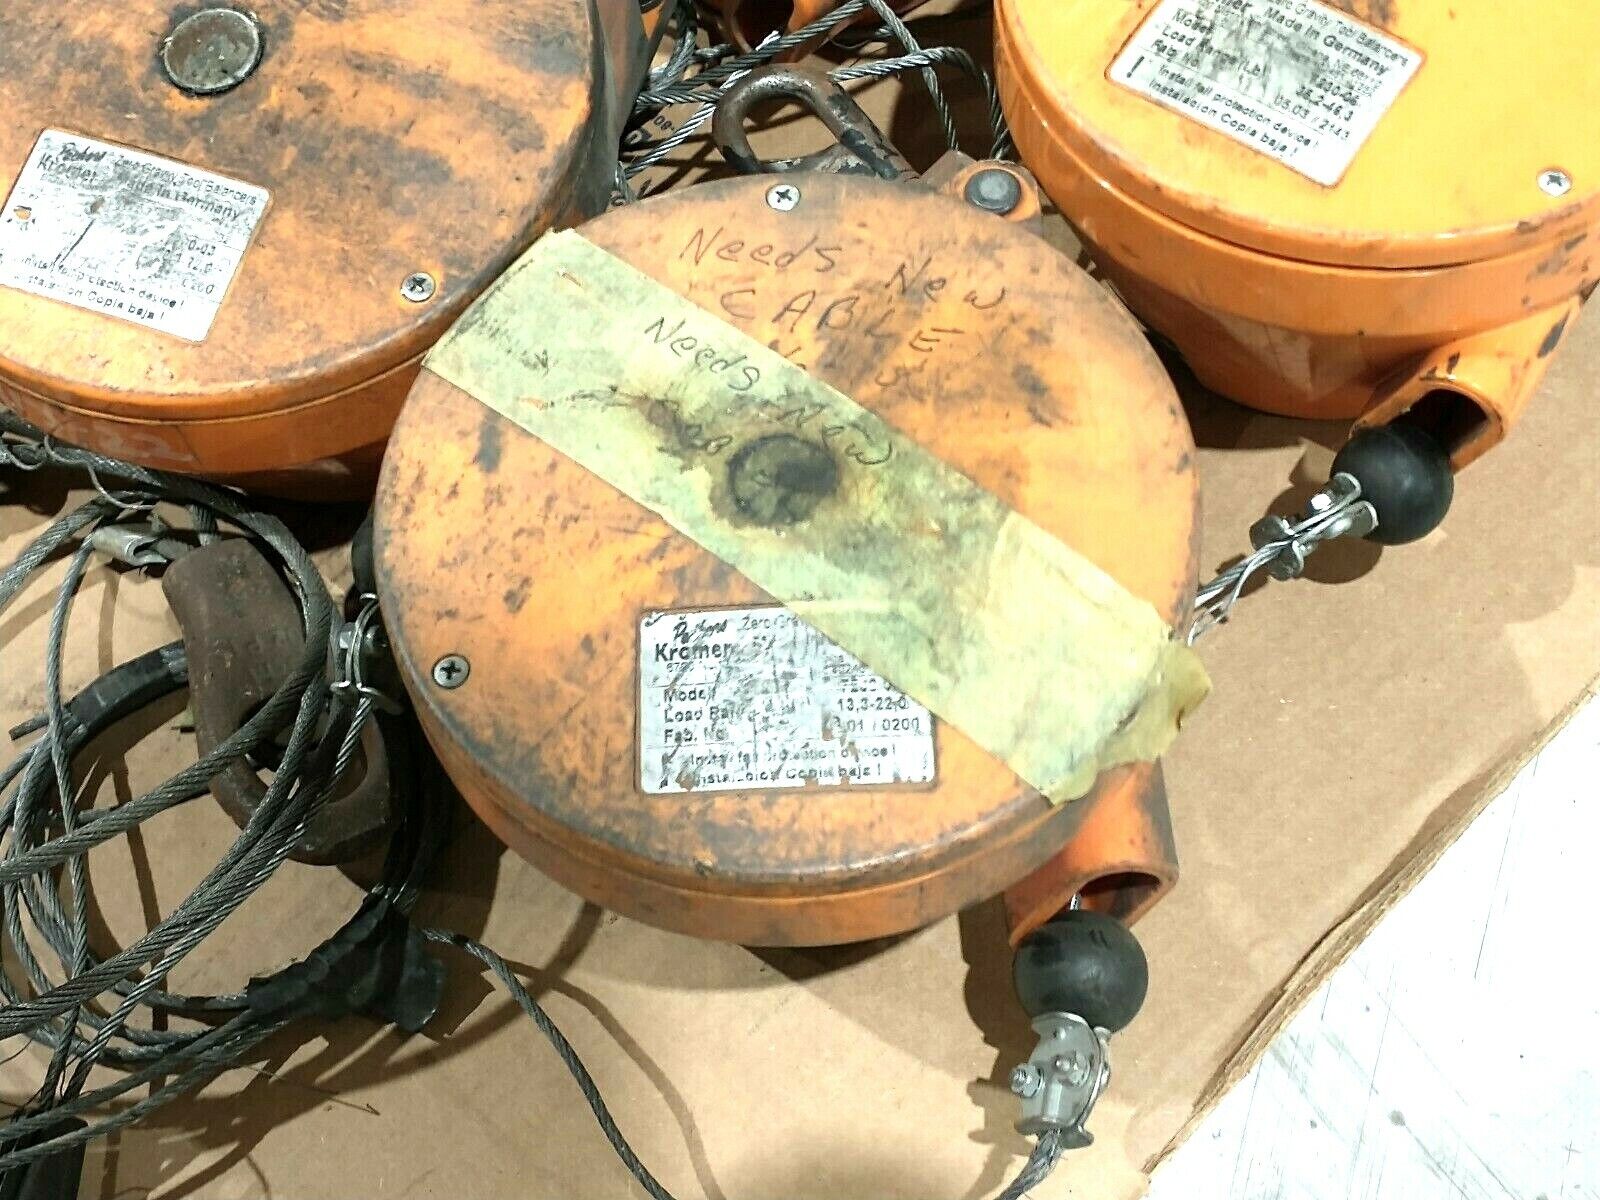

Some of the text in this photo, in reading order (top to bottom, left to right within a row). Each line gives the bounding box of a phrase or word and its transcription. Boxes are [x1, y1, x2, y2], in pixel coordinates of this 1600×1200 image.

[1162, 23, 1196, 47] Load
[1264, 6, 1303, 32] Made
[1323, 34, 1389, 76] Germany
[1213, 93, 1272, 125] protection
[1272, 122, 1311, 147] device
[680, 226, 843, 273] Needs
[87, 289, 125, 309] Copia
[127, 302, 155, 320] baja
[884, 255, 1007, 311] New
[719, 288, 967, 353] CABLE
[644, 316, 761, 392] Needs
[654, 640, 735, 663] Kromer
[663, 706, 704, 724] Load
